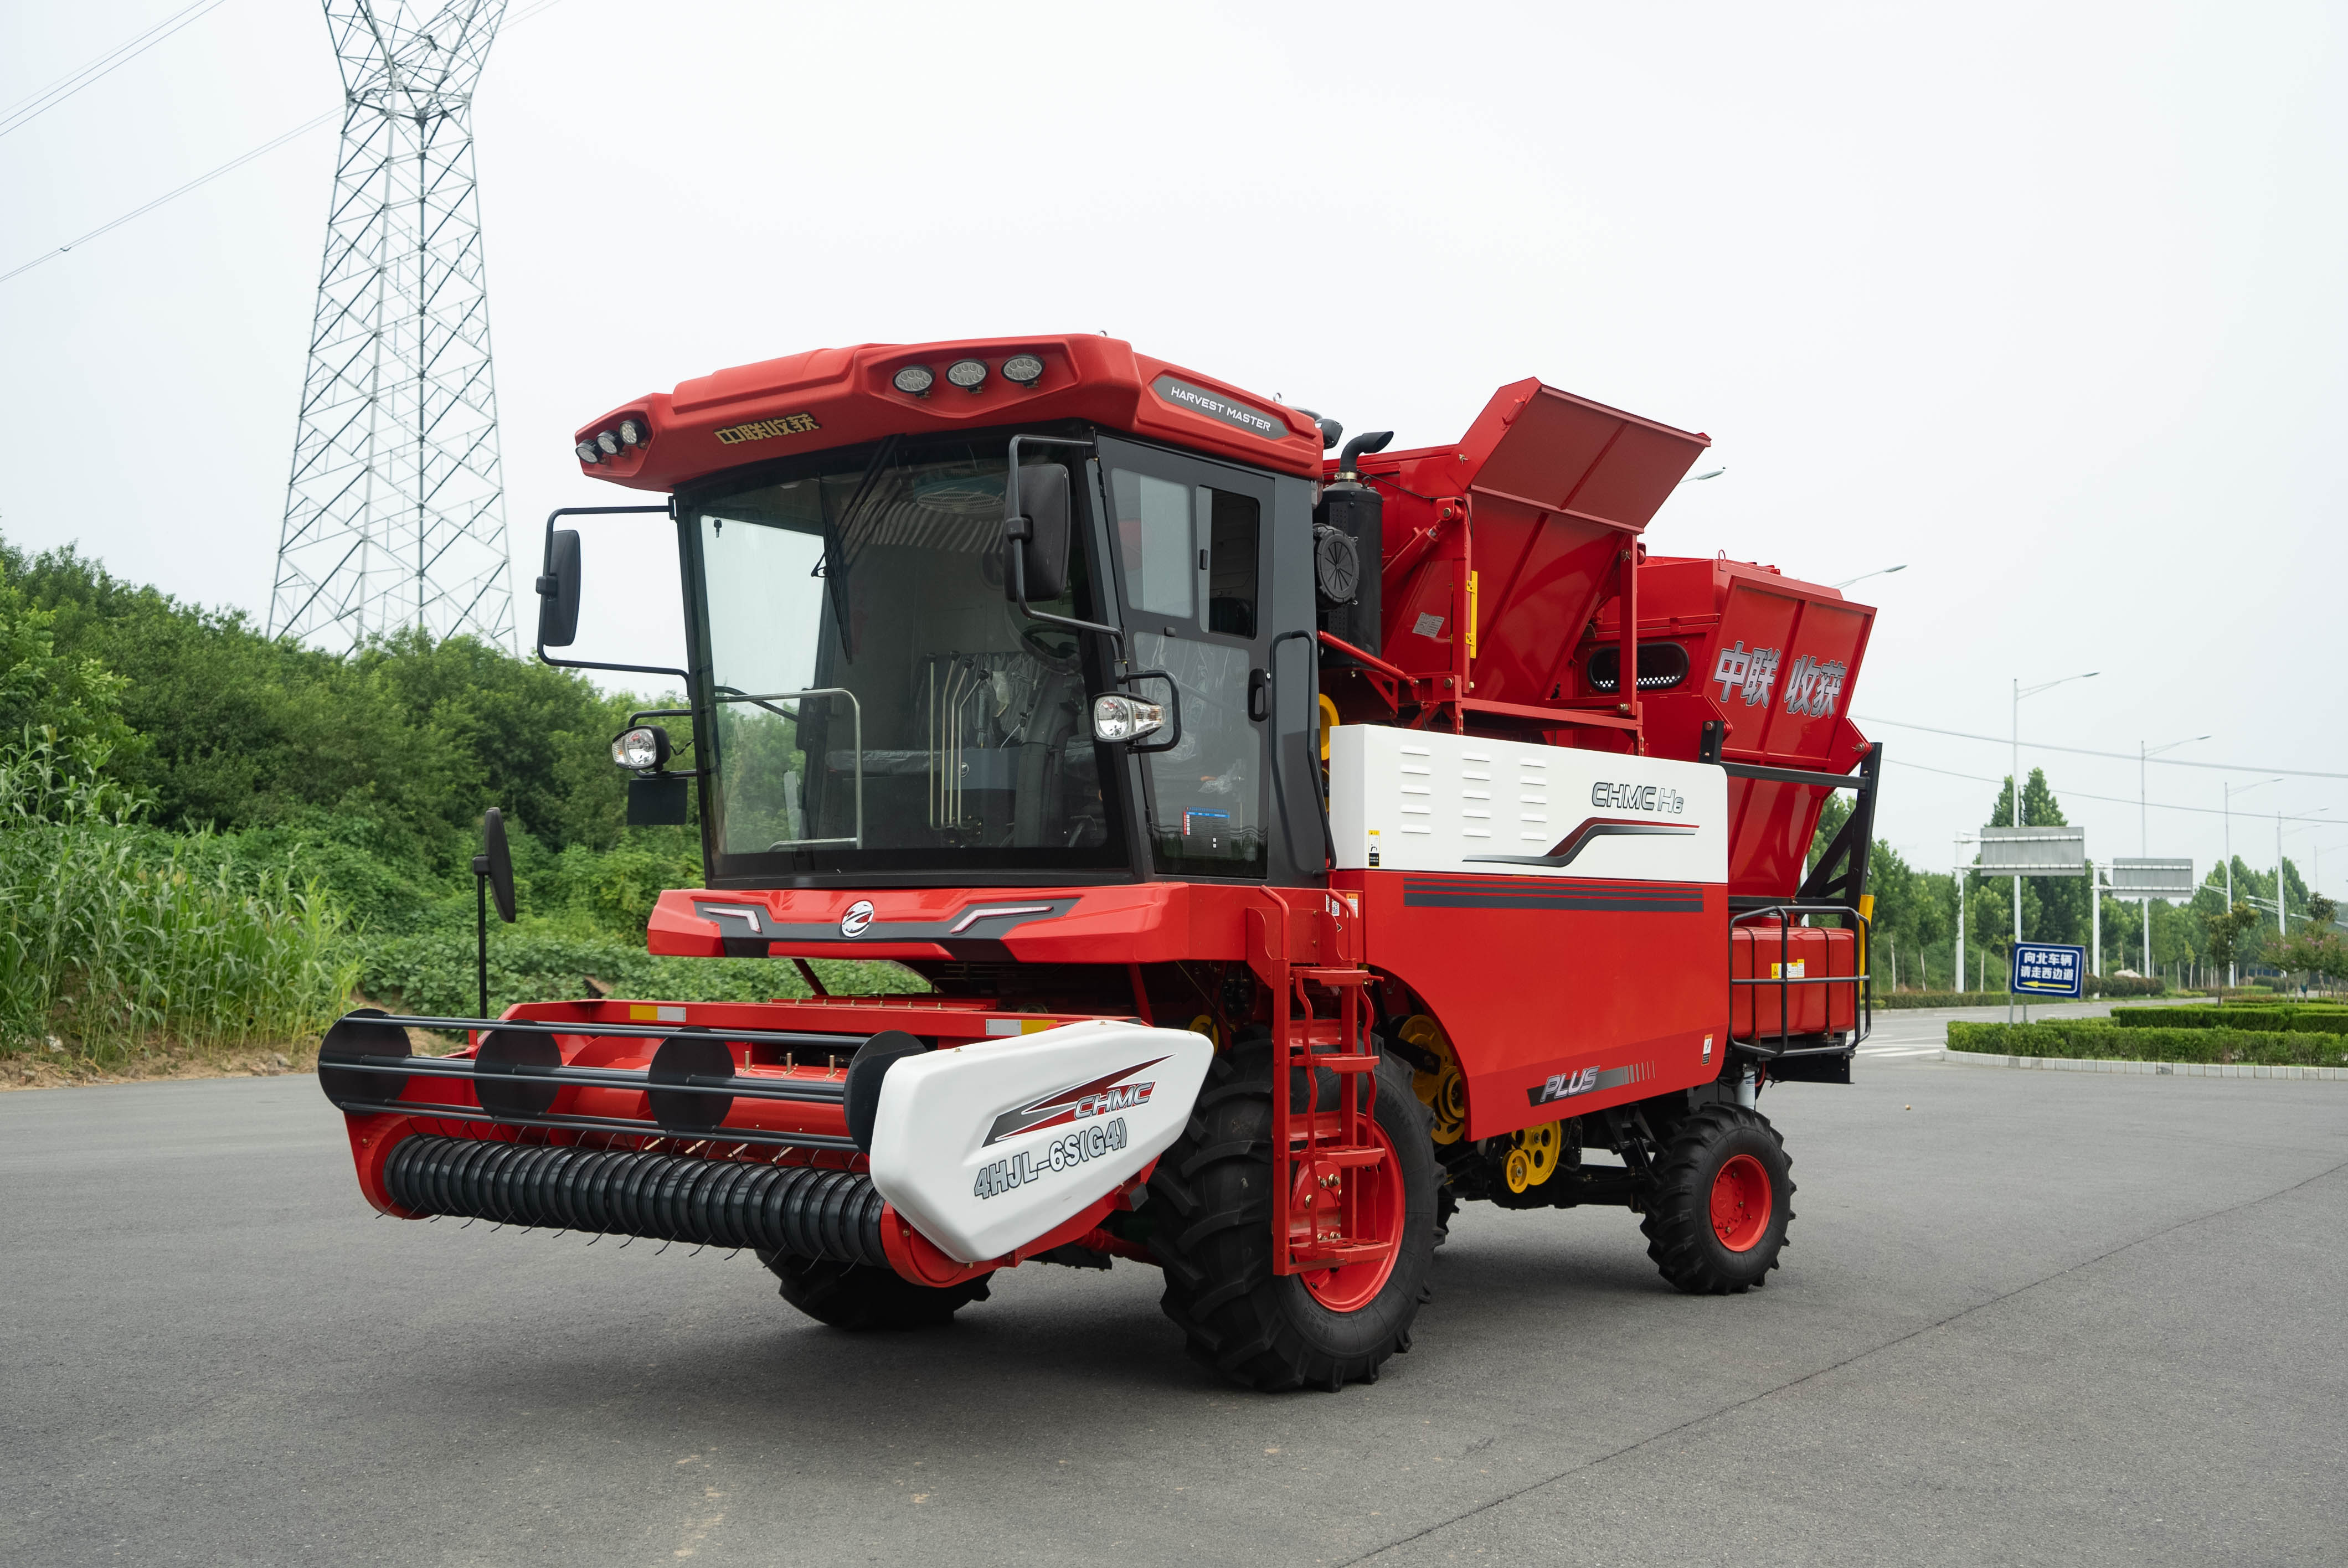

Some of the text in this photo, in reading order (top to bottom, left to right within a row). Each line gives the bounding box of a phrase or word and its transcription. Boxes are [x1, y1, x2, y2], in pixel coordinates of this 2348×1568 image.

[1171, 386, 1271, 432] HARVEST MASTER
[713, 413, 820, 445] 中联收获
[1592, 782, 1657, 811] CHMC
[2021, 965, 2074, 981] 请走西边道
[2024, 951, 2073, 966] 向北车辆
[1074, 1081, 1154, 1120] CHMC
[1539, 1065, 1601, 1103] PLUS
[974, 1117, 1127, 1199] 4HJL-6S(G4)
